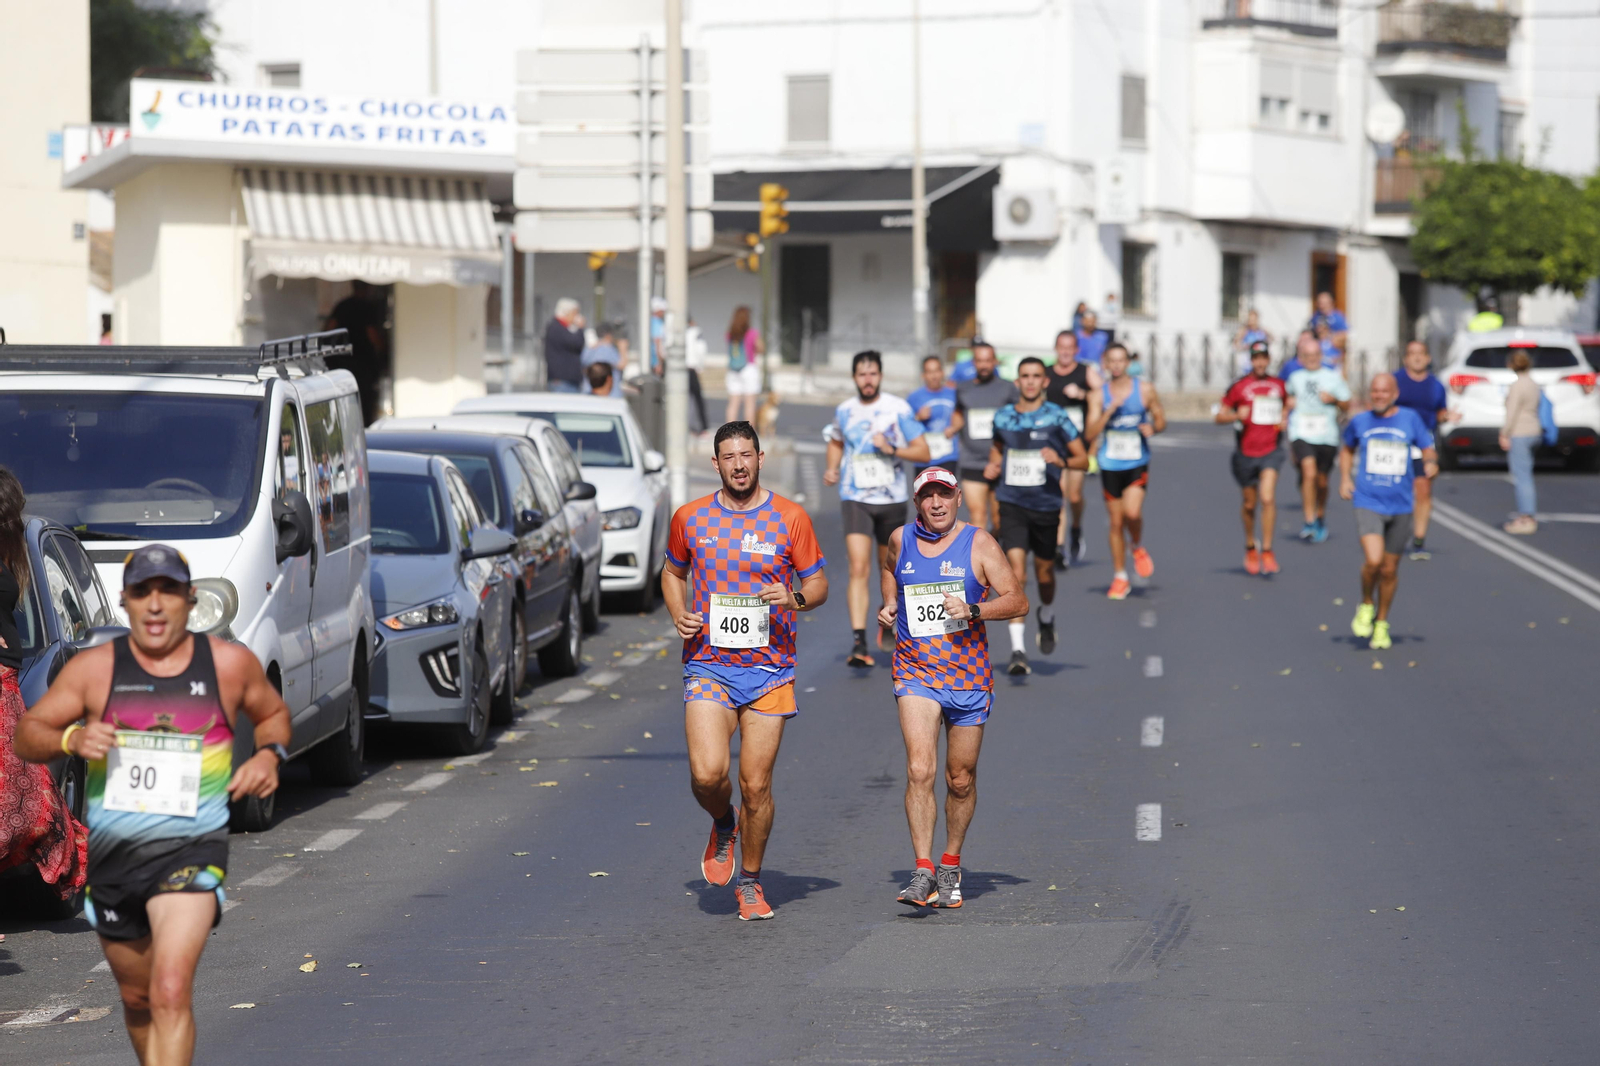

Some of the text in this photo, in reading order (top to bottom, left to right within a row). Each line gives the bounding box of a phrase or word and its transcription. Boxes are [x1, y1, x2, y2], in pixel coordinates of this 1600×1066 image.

[178, 90, 328, 114] CHURROS
[360, 99, 513, 123] CHOCOLA
[222, 118, 487, 147] PATATAS FRITAS
[915, 585, 935, 594] VUELTA
[935, 585, 940, 593] A
[940, 583, 960, 592] HUELVA
[722, 597, 741, 606] VUELTA
[742, 598, 747, 606] A
[917, 603, 946, 622] 362
[720, 616, 750, 634] 408
[130, 765, 157, 790] 90
